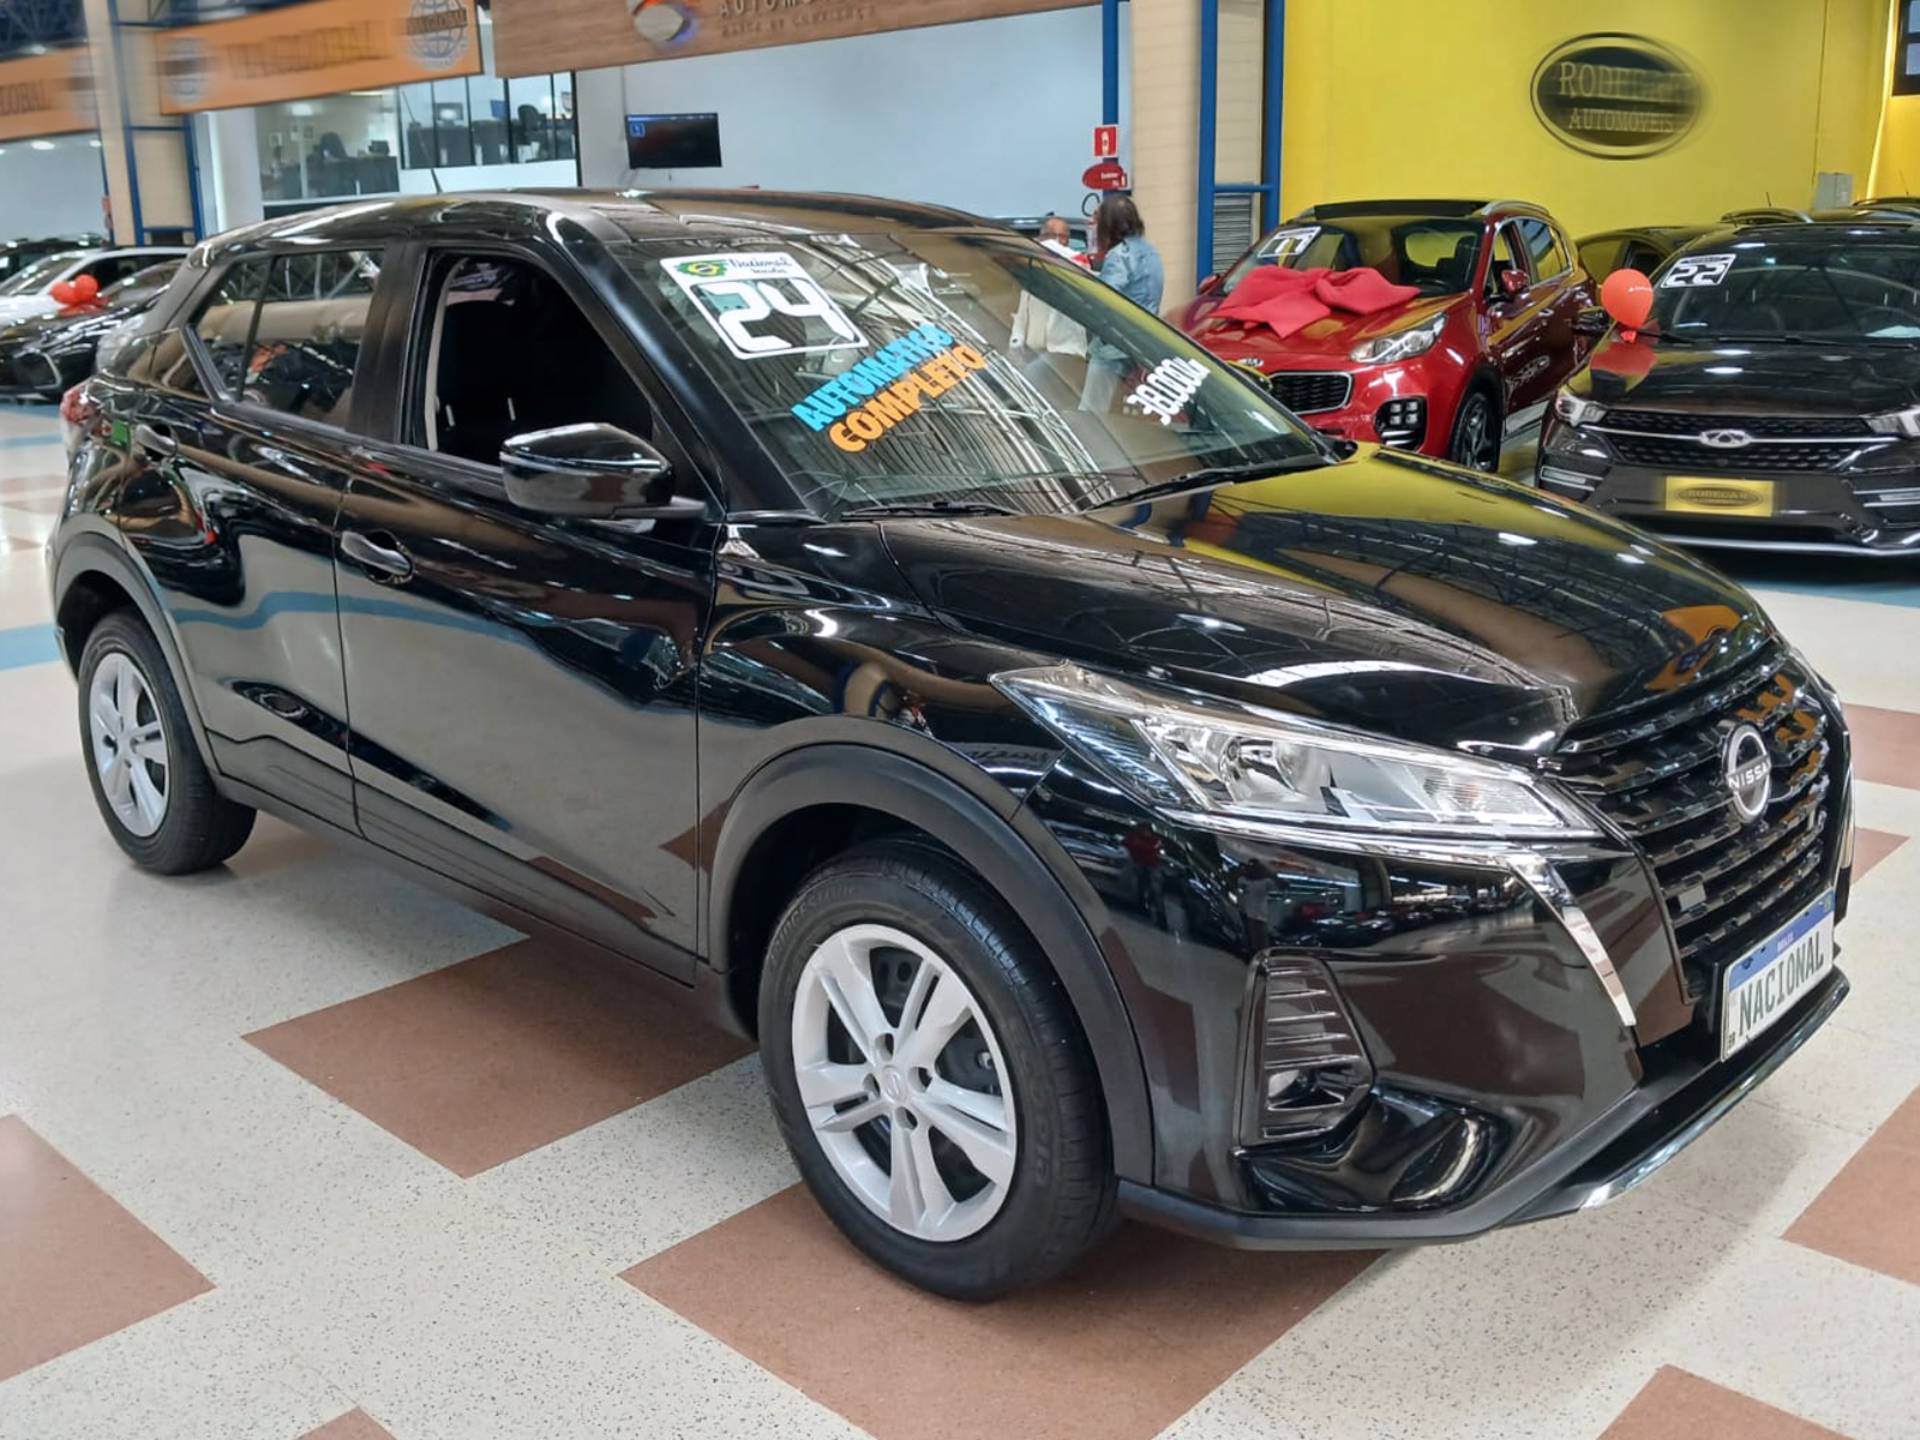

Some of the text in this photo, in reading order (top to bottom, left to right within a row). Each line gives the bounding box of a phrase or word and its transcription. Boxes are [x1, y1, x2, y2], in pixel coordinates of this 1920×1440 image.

[698, 277, 858, 351] 24
[828, 344, 989, 453] COMPLETO
[1739, 931, 1824, 1037] NACIONAL
